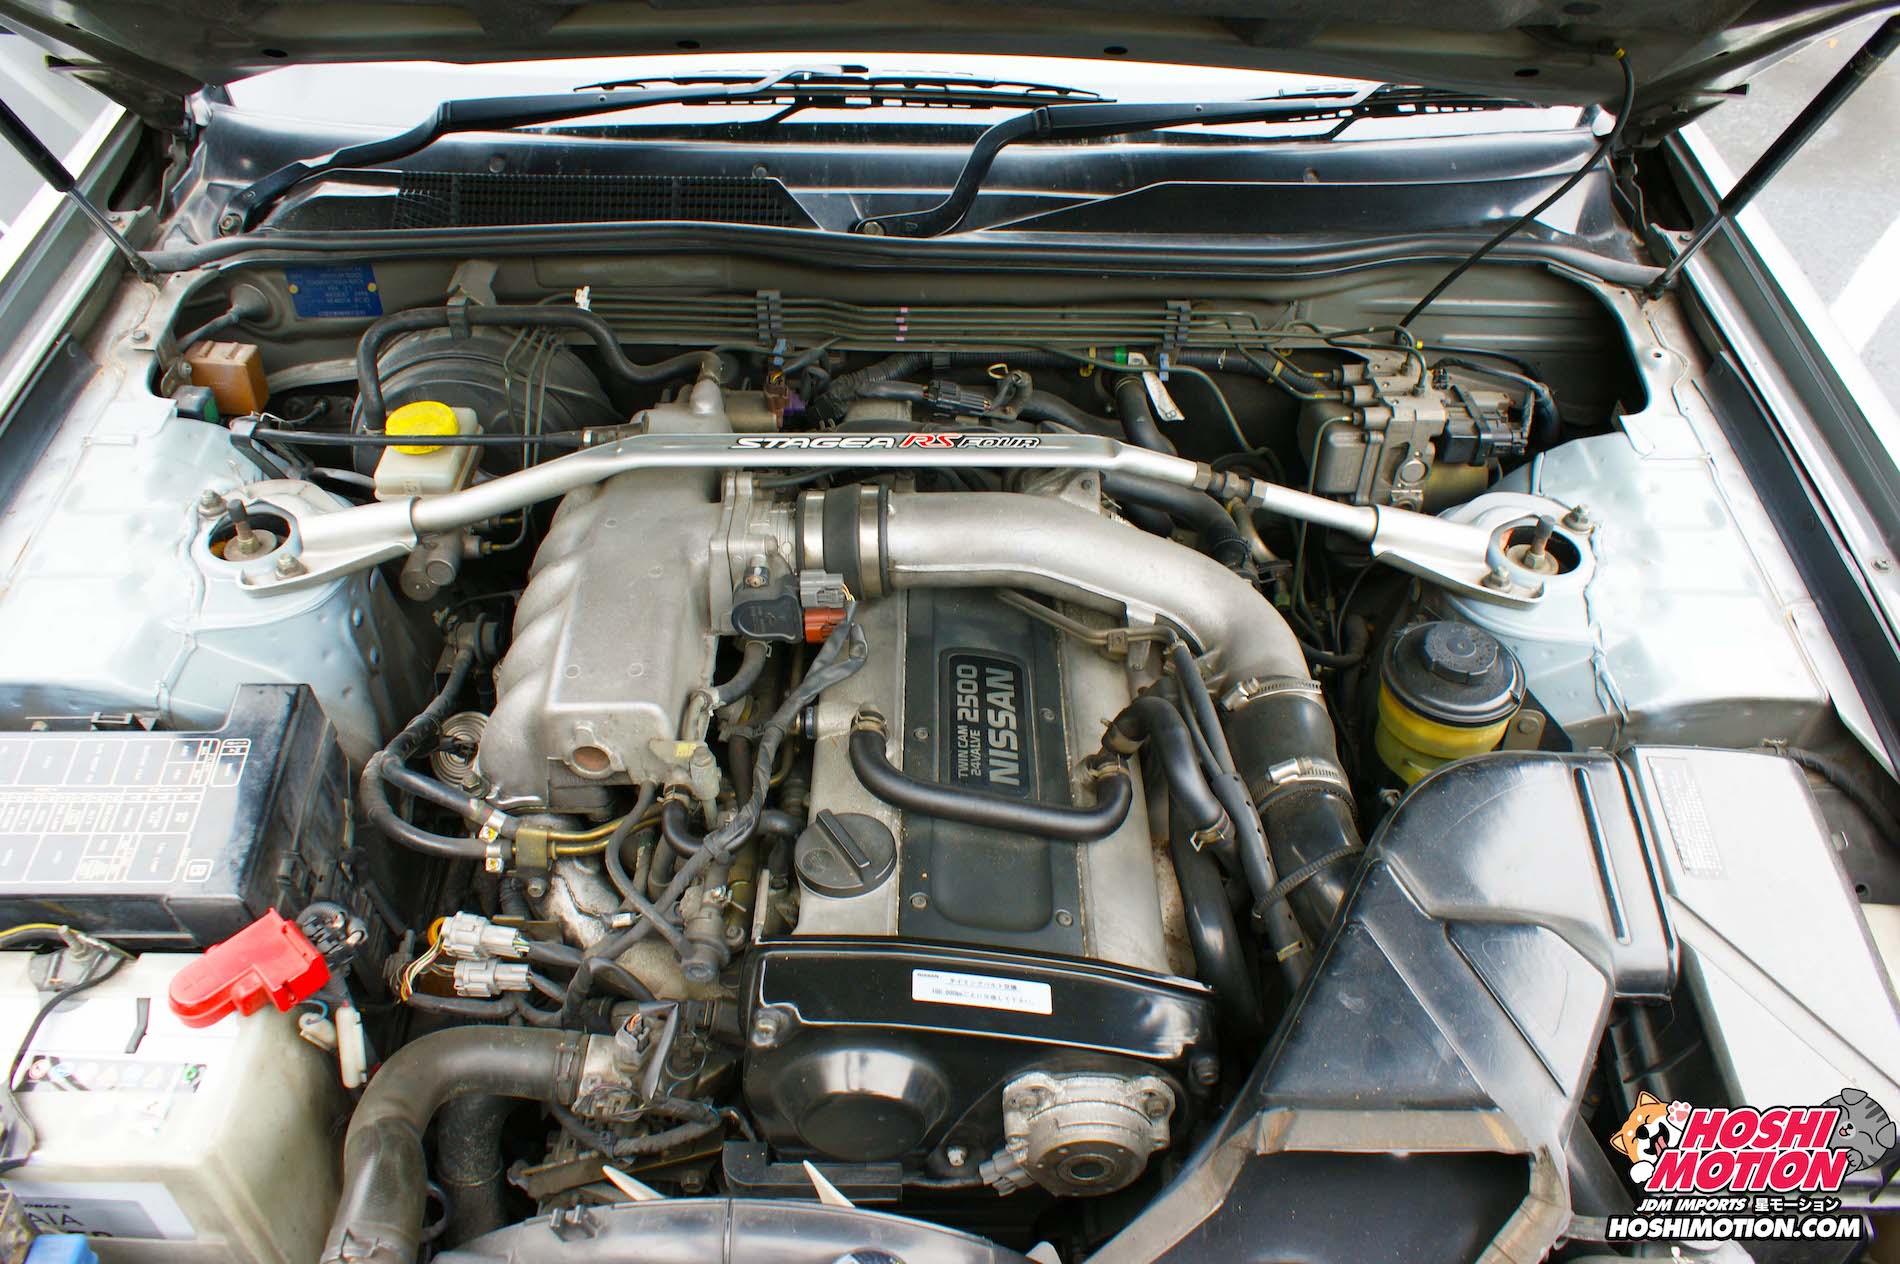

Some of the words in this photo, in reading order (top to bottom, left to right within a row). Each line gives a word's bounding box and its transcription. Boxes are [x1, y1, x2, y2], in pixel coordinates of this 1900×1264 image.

[729, 436, 895, 449] STAGEA
[899, 433, 963, 448] RS
[957, 436, 1041, 449] FOUR
[956, 664, 980, 723] 2500
[957, 725, 969, 749] CAM
[985, 667, 1020, 786] NISSAN
[958, 750, 969, 778] TWIN
[970, 729, 981, 777] 24VALVE
